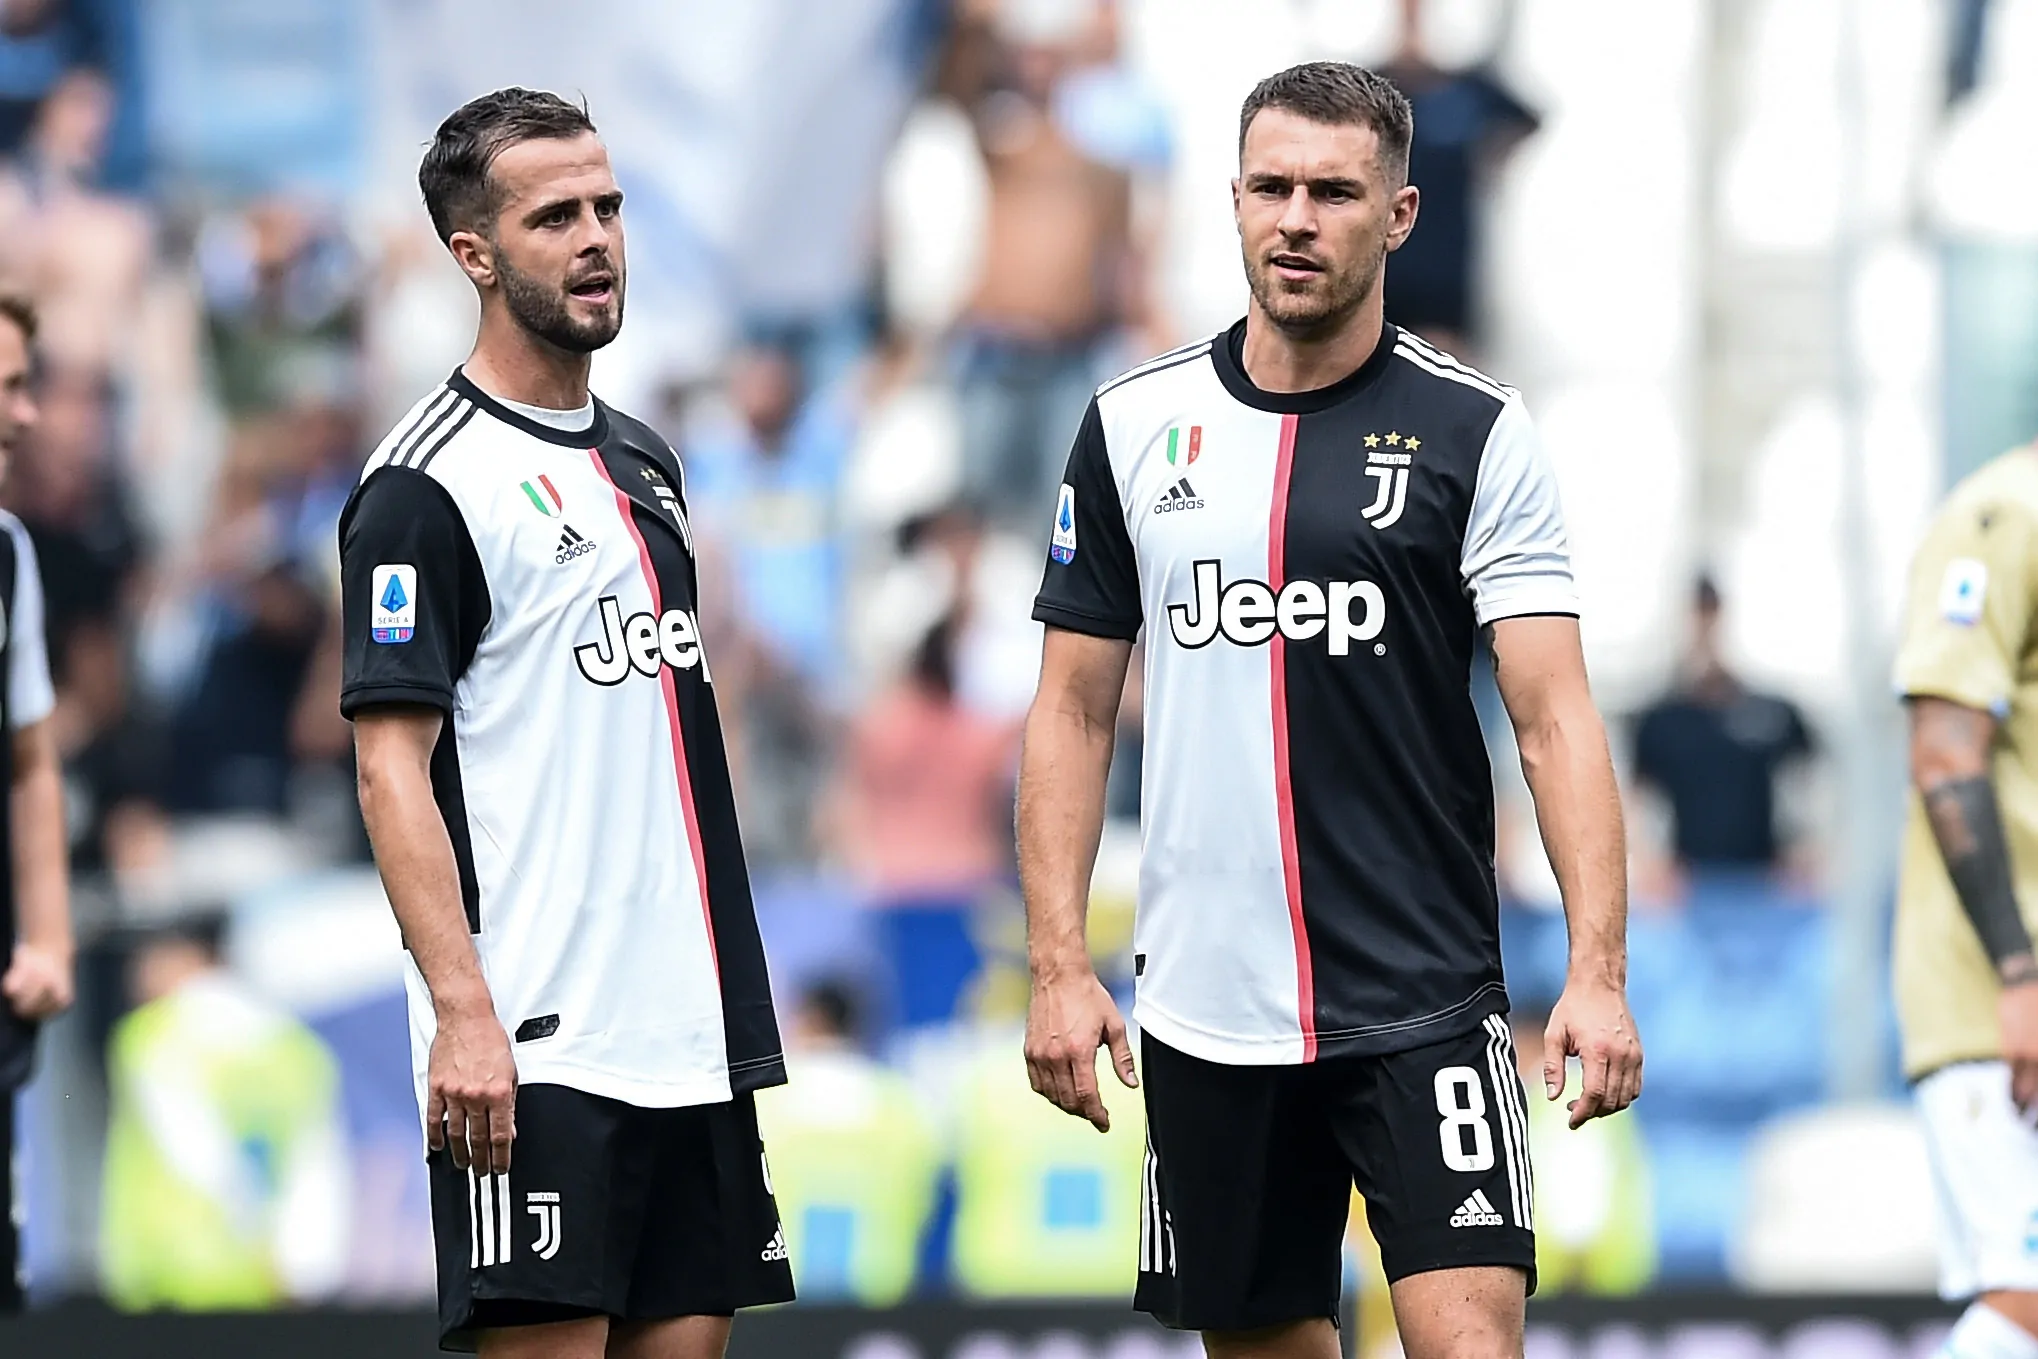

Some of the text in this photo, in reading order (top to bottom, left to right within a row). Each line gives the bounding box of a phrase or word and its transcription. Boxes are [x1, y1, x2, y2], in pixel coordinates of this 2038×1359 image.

[1154, 497, 1205, 514] adidas
[555, 540, 597, 565] adidas
[1166, 558, 1387, 657] Jeep
[1433, 1065, 1496, 1172] 8
[1449, 1211, 1504, 1228] adidas
